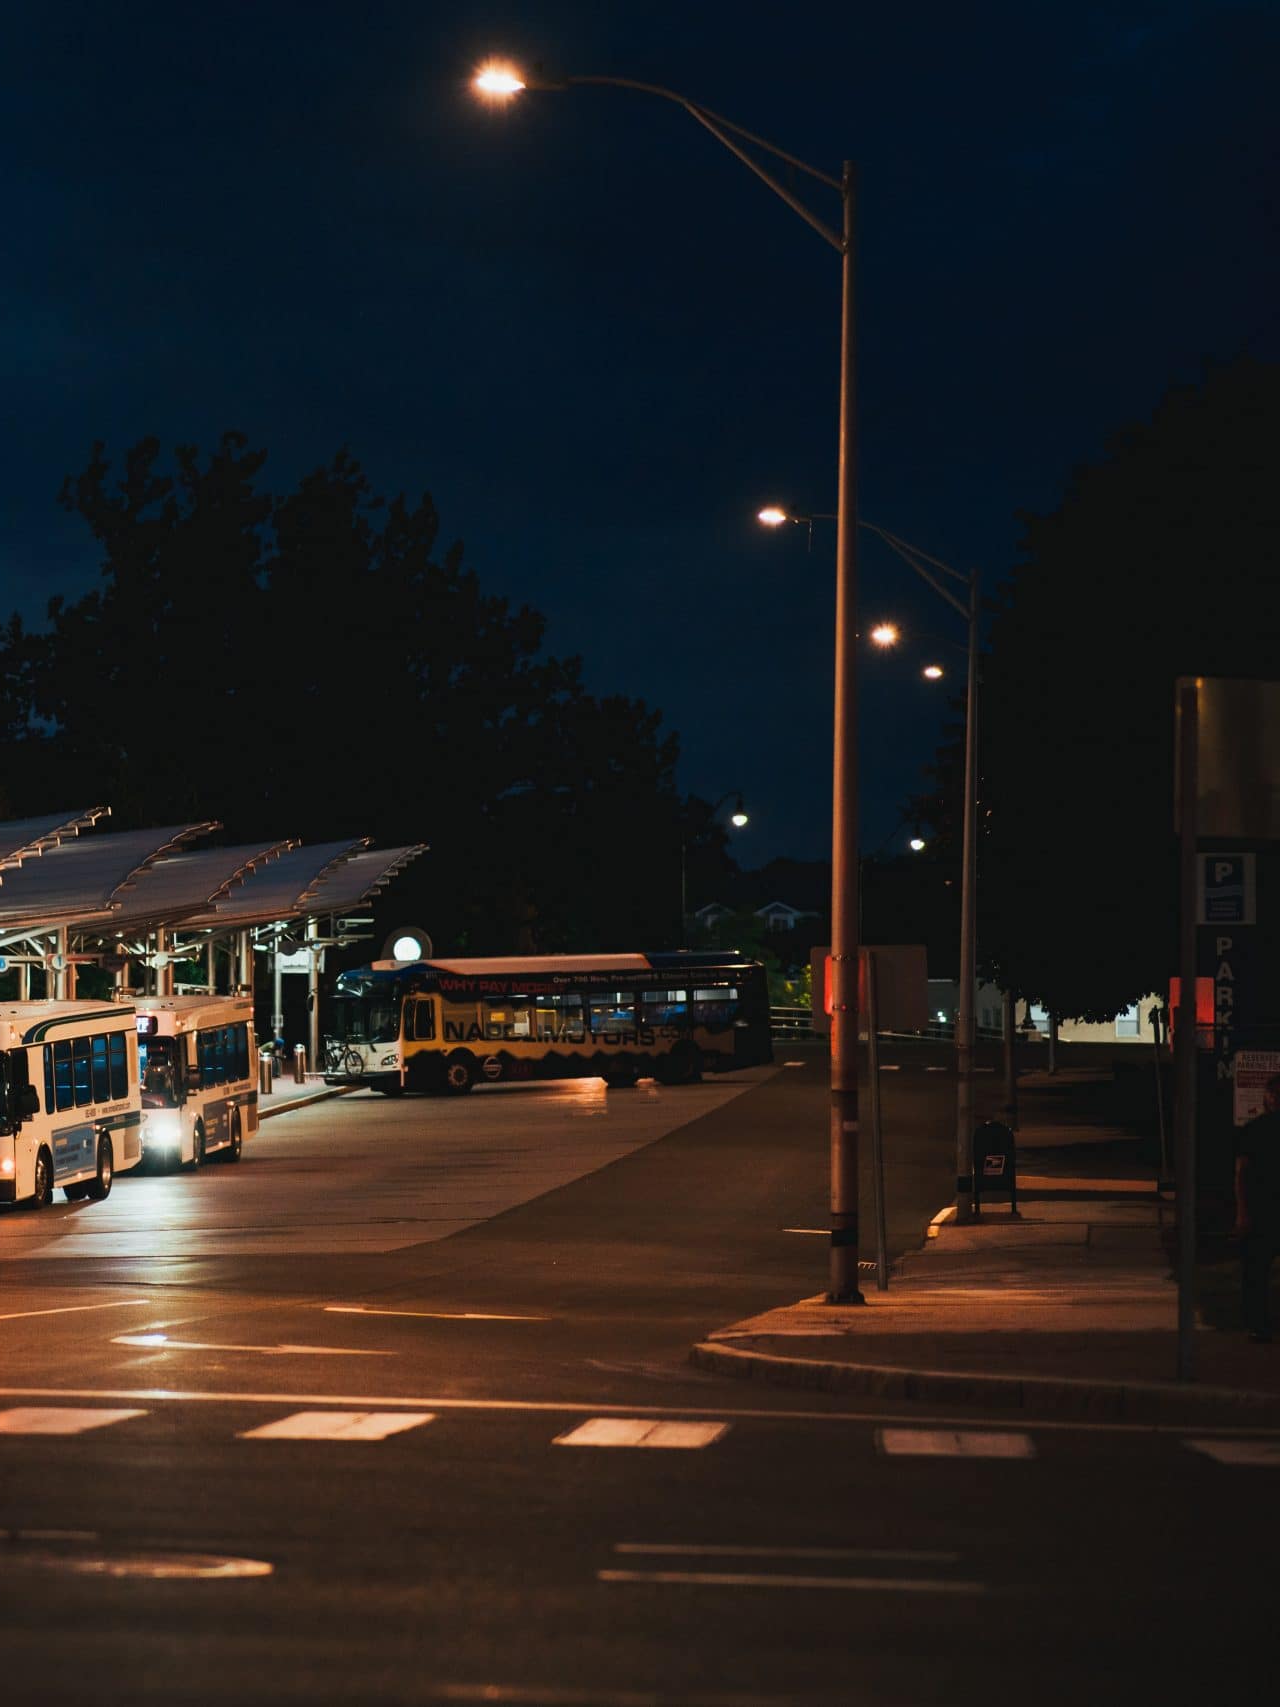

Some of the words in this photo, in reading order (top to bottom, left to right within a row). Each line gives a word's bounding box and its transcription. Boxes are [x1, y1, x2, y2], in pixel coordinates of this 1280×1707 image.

[1214, 862, 1233, 882] P
[440, 977, 476, 993] WHY
[479, 979, 509, 993] PAY
